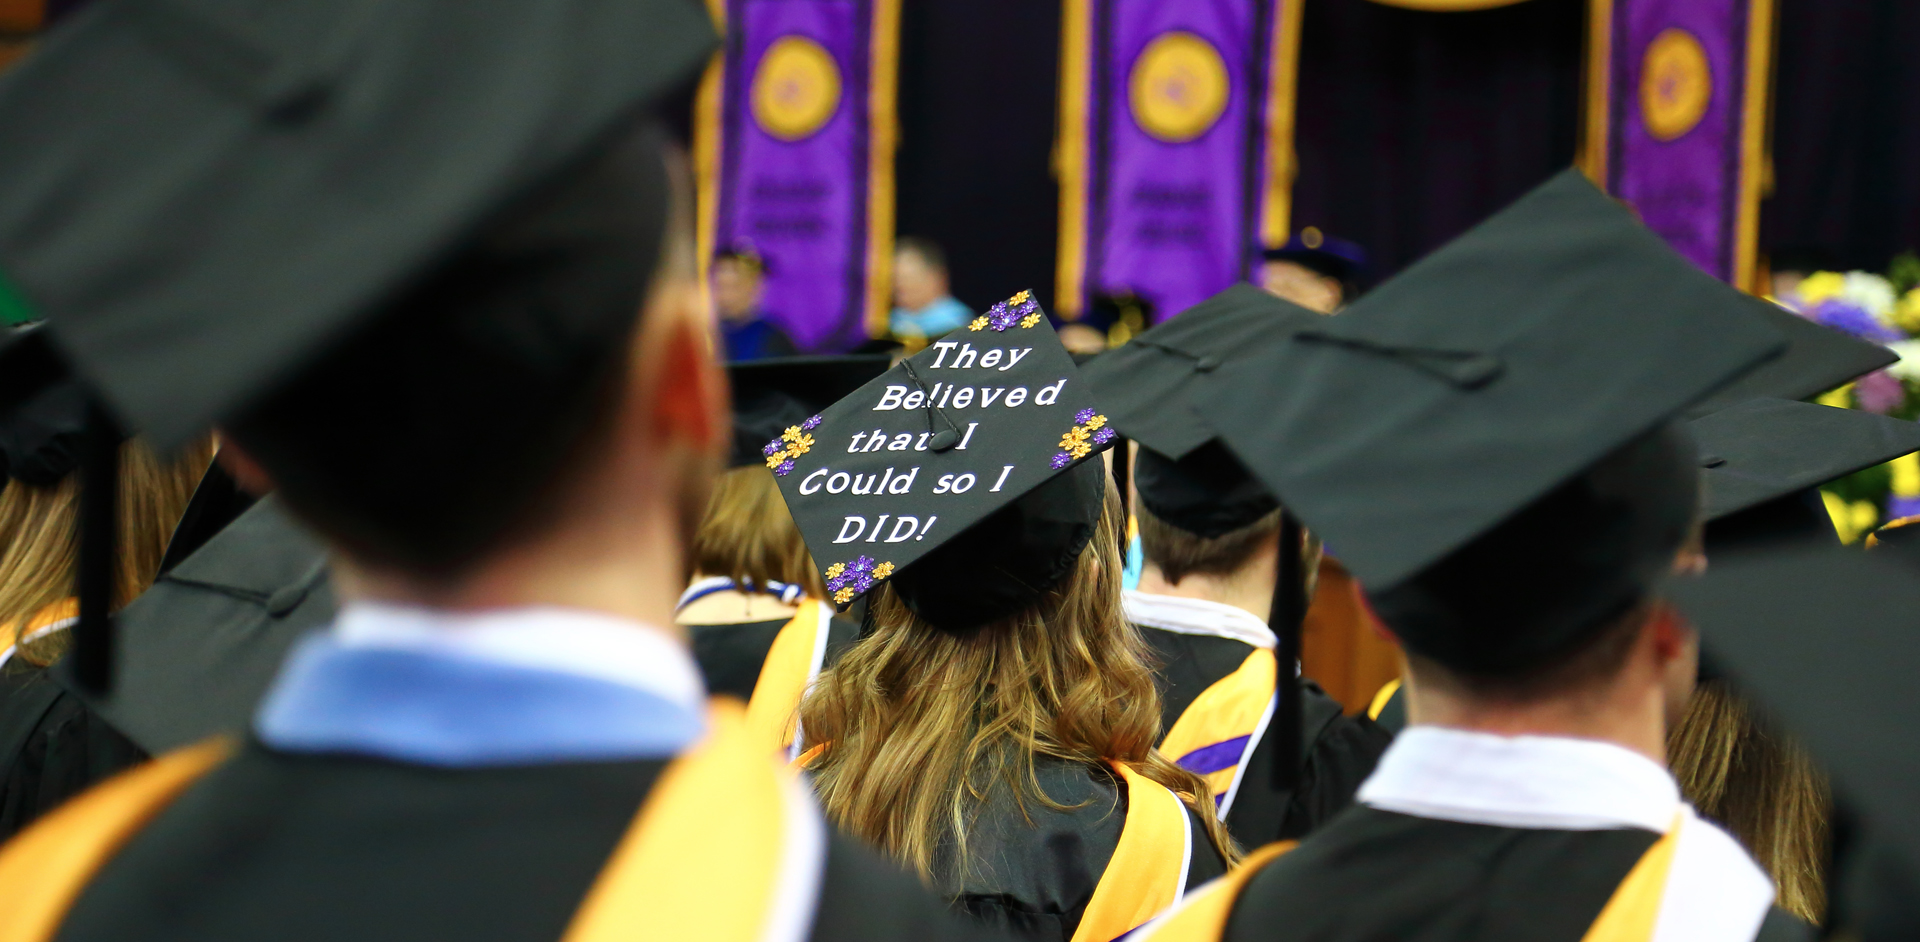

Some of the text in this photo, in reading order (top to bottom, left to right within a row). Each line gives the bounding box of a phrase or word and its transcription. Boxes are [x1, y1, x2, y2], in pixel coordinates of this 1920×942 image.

[929, 341, 1033, 372] They
[872, 378, 1068, 411] Believed
[847, 422, 979, 454] that I
[798, 465, 1015, 496] Could so I
[831, 514, 938, 544] DID!
